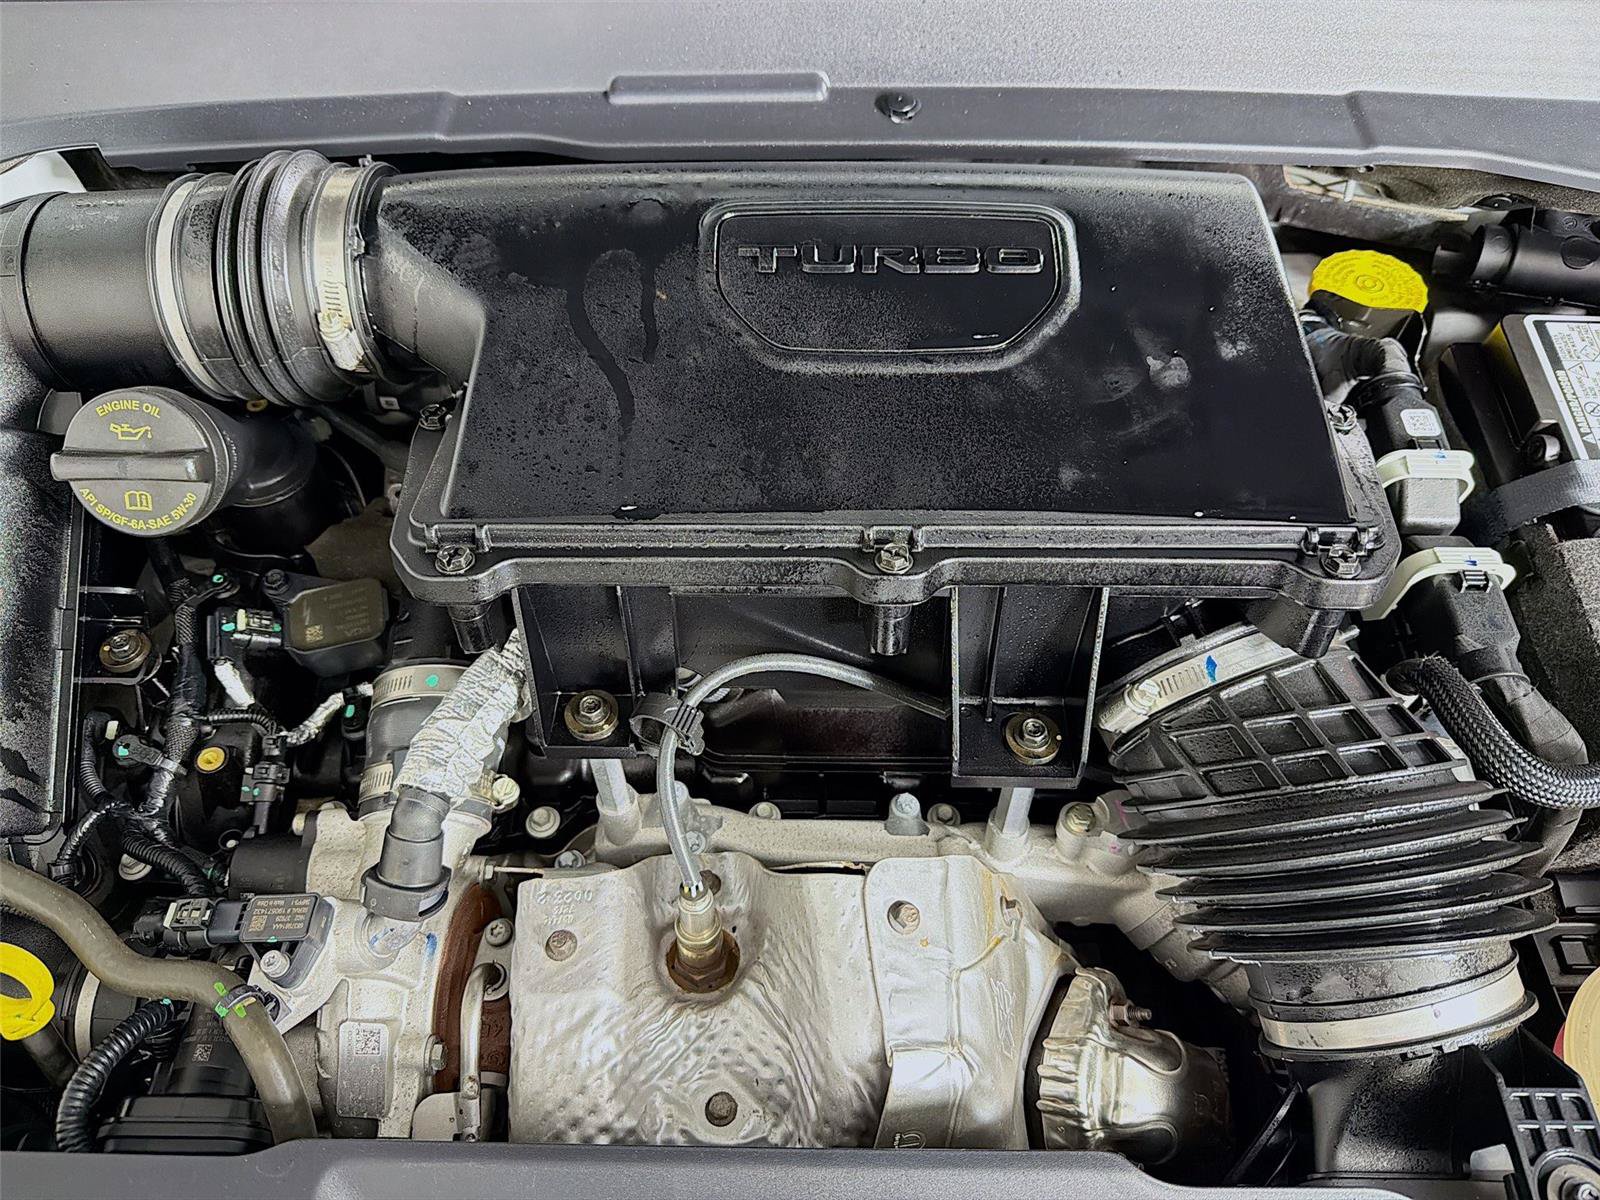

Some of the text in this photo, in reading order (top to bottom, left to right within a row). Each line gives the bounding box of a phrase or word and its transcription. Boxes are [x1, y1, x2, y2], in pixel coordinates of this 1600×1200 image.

[738, 244, 1044, 274] TURBO
[95, 399, 161, 418] ENGINE OIL
[80, 487, 98, 506] API
[170, 492, 197, 520] 5W-30
